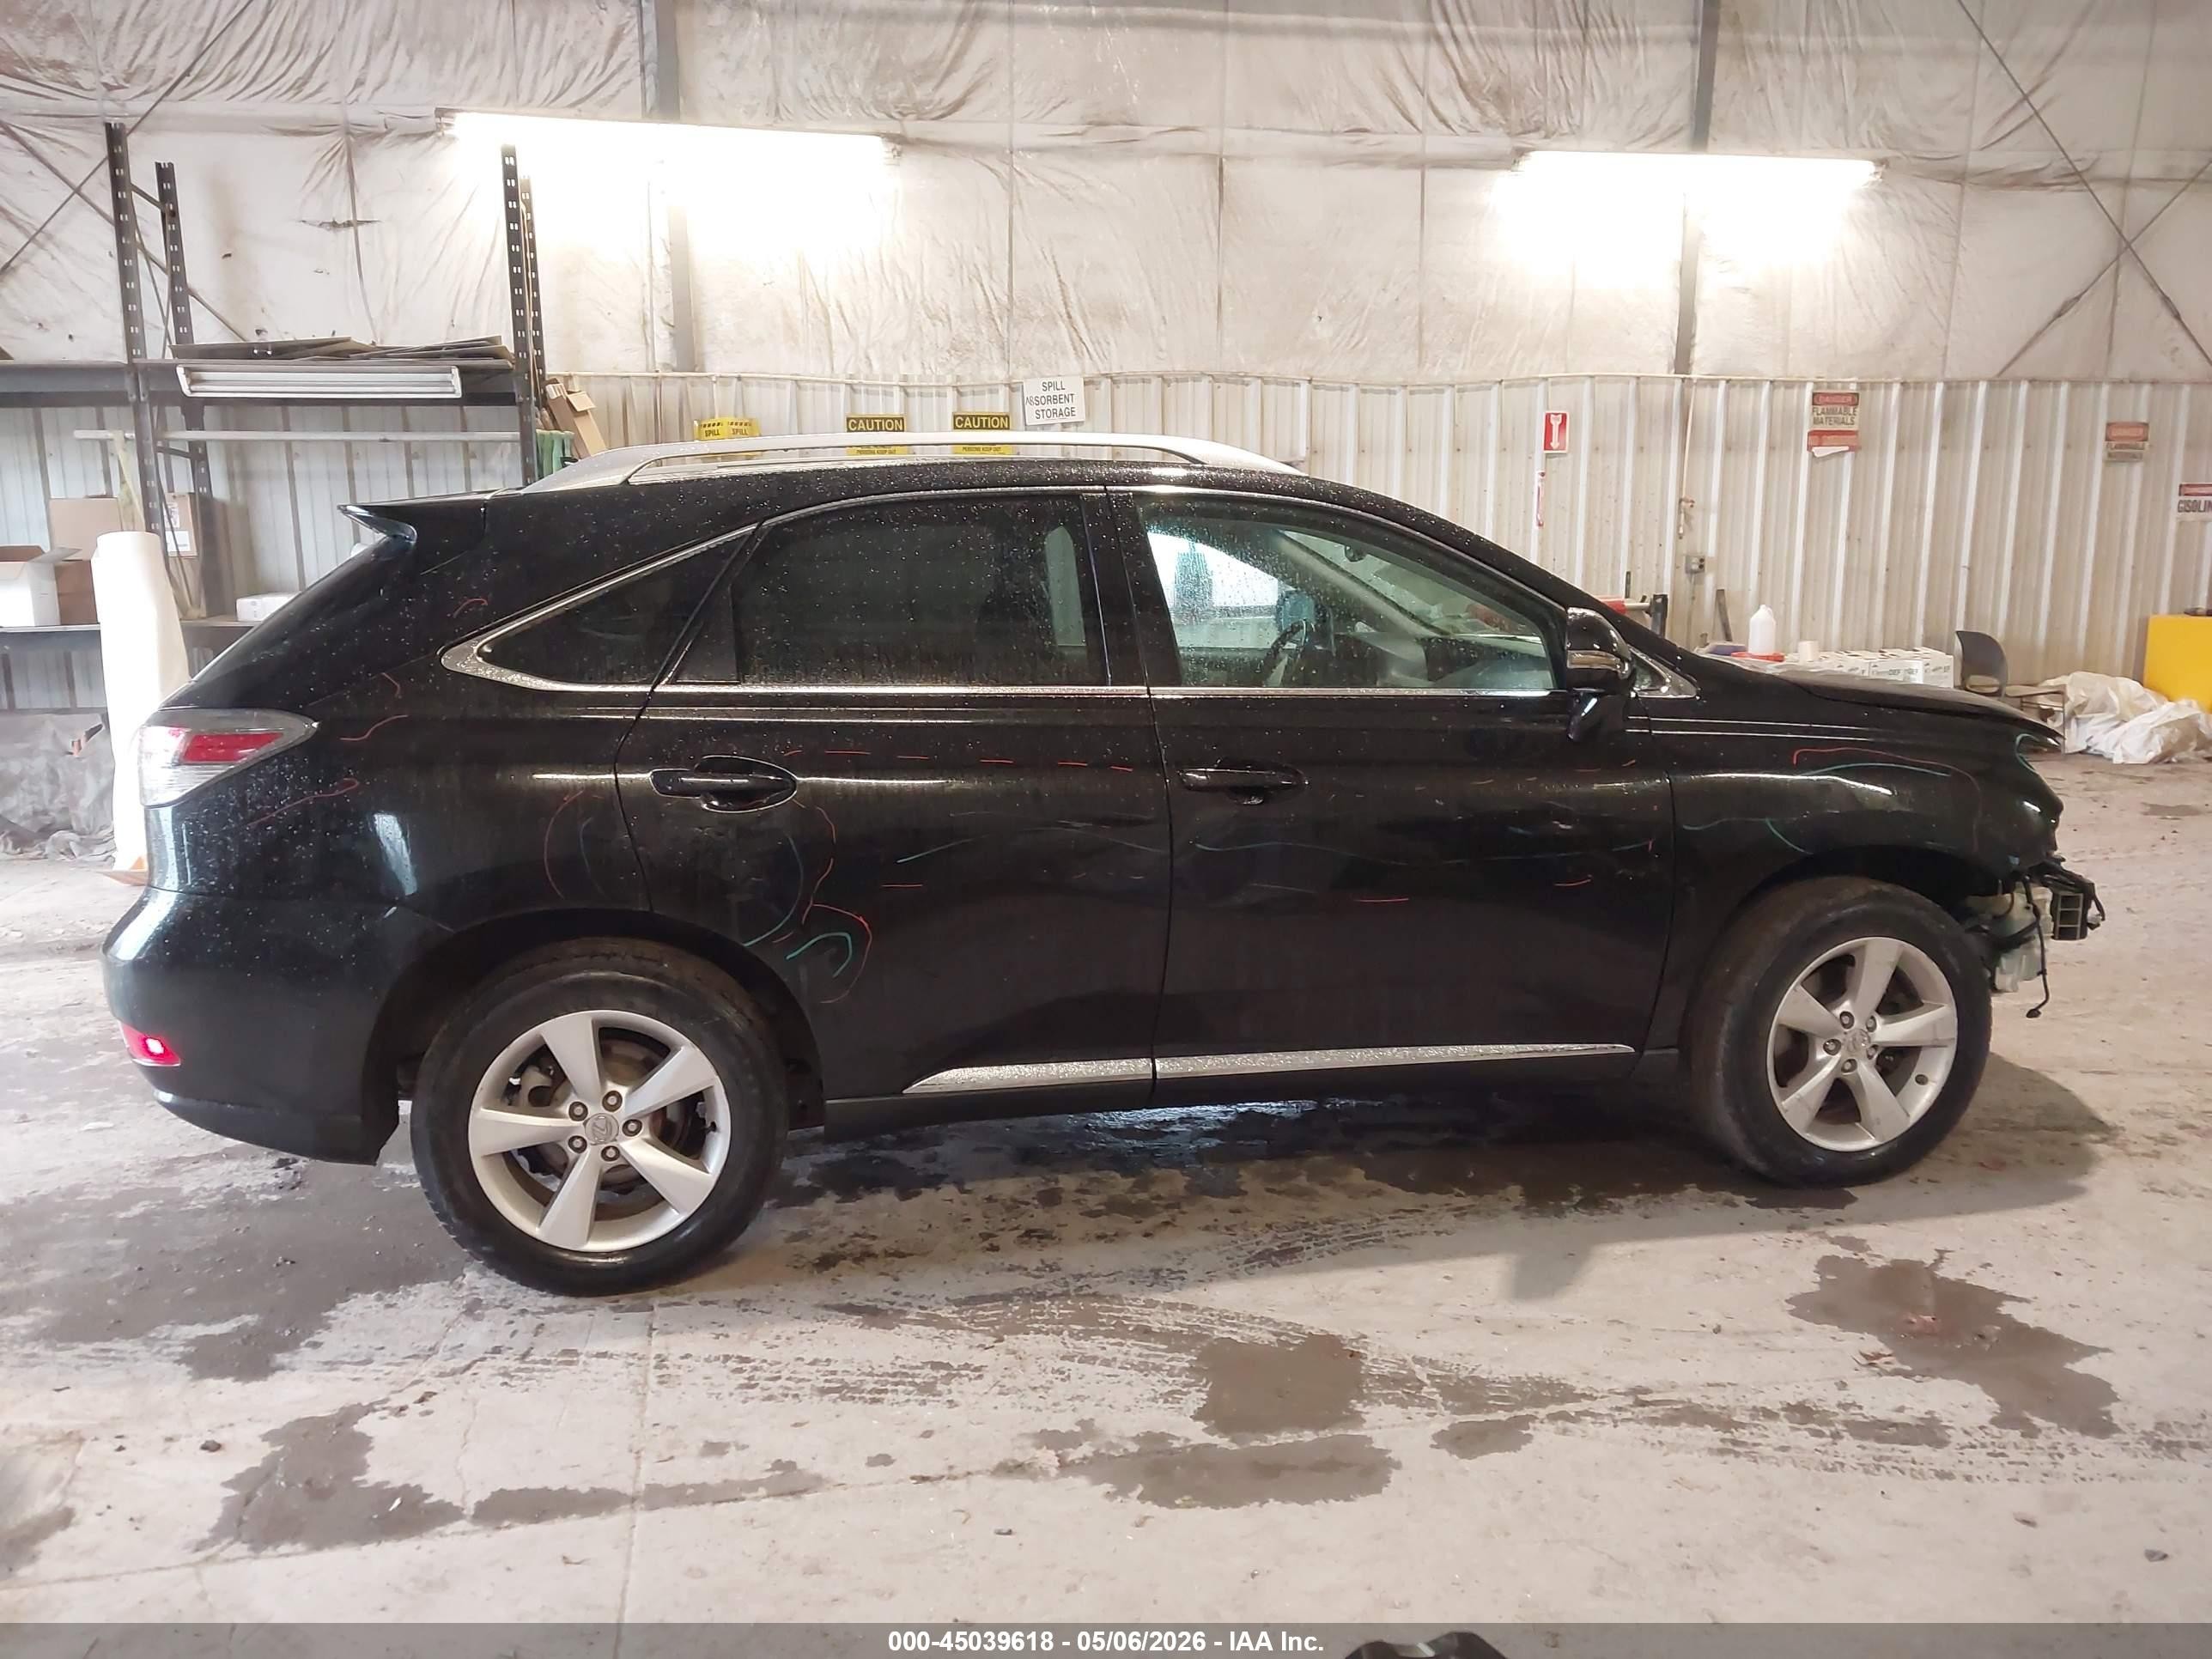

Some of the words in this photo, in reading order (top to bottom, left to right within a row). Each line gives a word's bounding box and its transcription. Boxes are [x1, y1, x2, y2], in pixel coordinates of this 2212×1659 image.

[1042, 381, 1066, 392] SPILL
[1025, 393, 1075, 406] ABSORBENT
[1035, 407, 1076, 419] STORAGE
[848, 418, 903, 431] CAUTION
[955, 416, 1008, 428] CAUTION
[1813, 416, 1856, 426] MATERIALS
